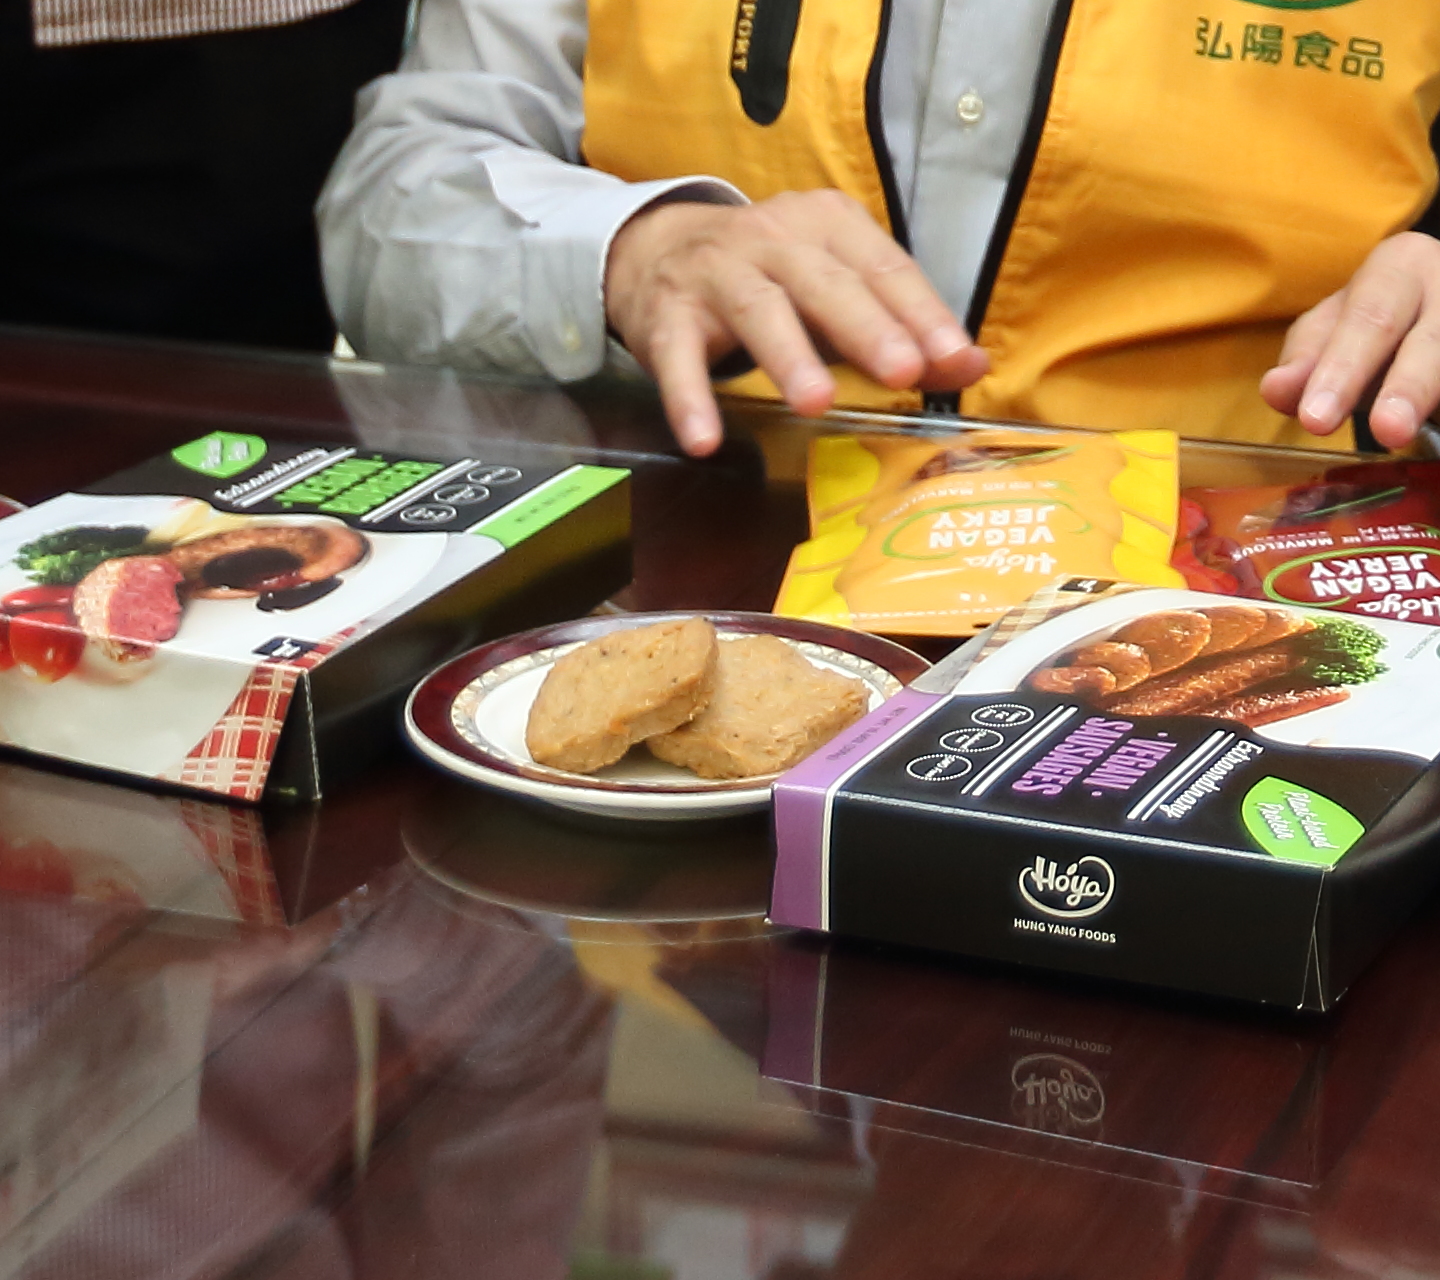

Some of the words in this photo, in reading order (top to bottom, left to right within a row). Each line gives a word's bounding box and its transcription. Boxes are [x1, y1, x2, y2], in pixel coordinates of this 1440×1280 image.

[1194, 15, 1386, 81] 弘陽食品
[931, 504, 1056, 529] JERKY
[928, 525, 1056, 550] VEGAN
[1229, 535, 1334, 562] MARVELOUS
[963, 548, 1058, 576] Hoya
[1308, 552, 1429, 580] JERKY
[1011, 716, 1135, 797] SAUSAGES
[1083, 737, 1178, 792] VEGAN
[1159, 739, 1265, 820] Extraordinary
[1255, 801, 1296, 841] Protein
[1283, 790, 1341, 850] Plant-based
[1030, 855, 1105, 907] Hoya
[1013, 917, 1046, 933] HUNG
[1046, 922, 1077, 938] YANG
[1078, 928, 1116, 943] FOODS
